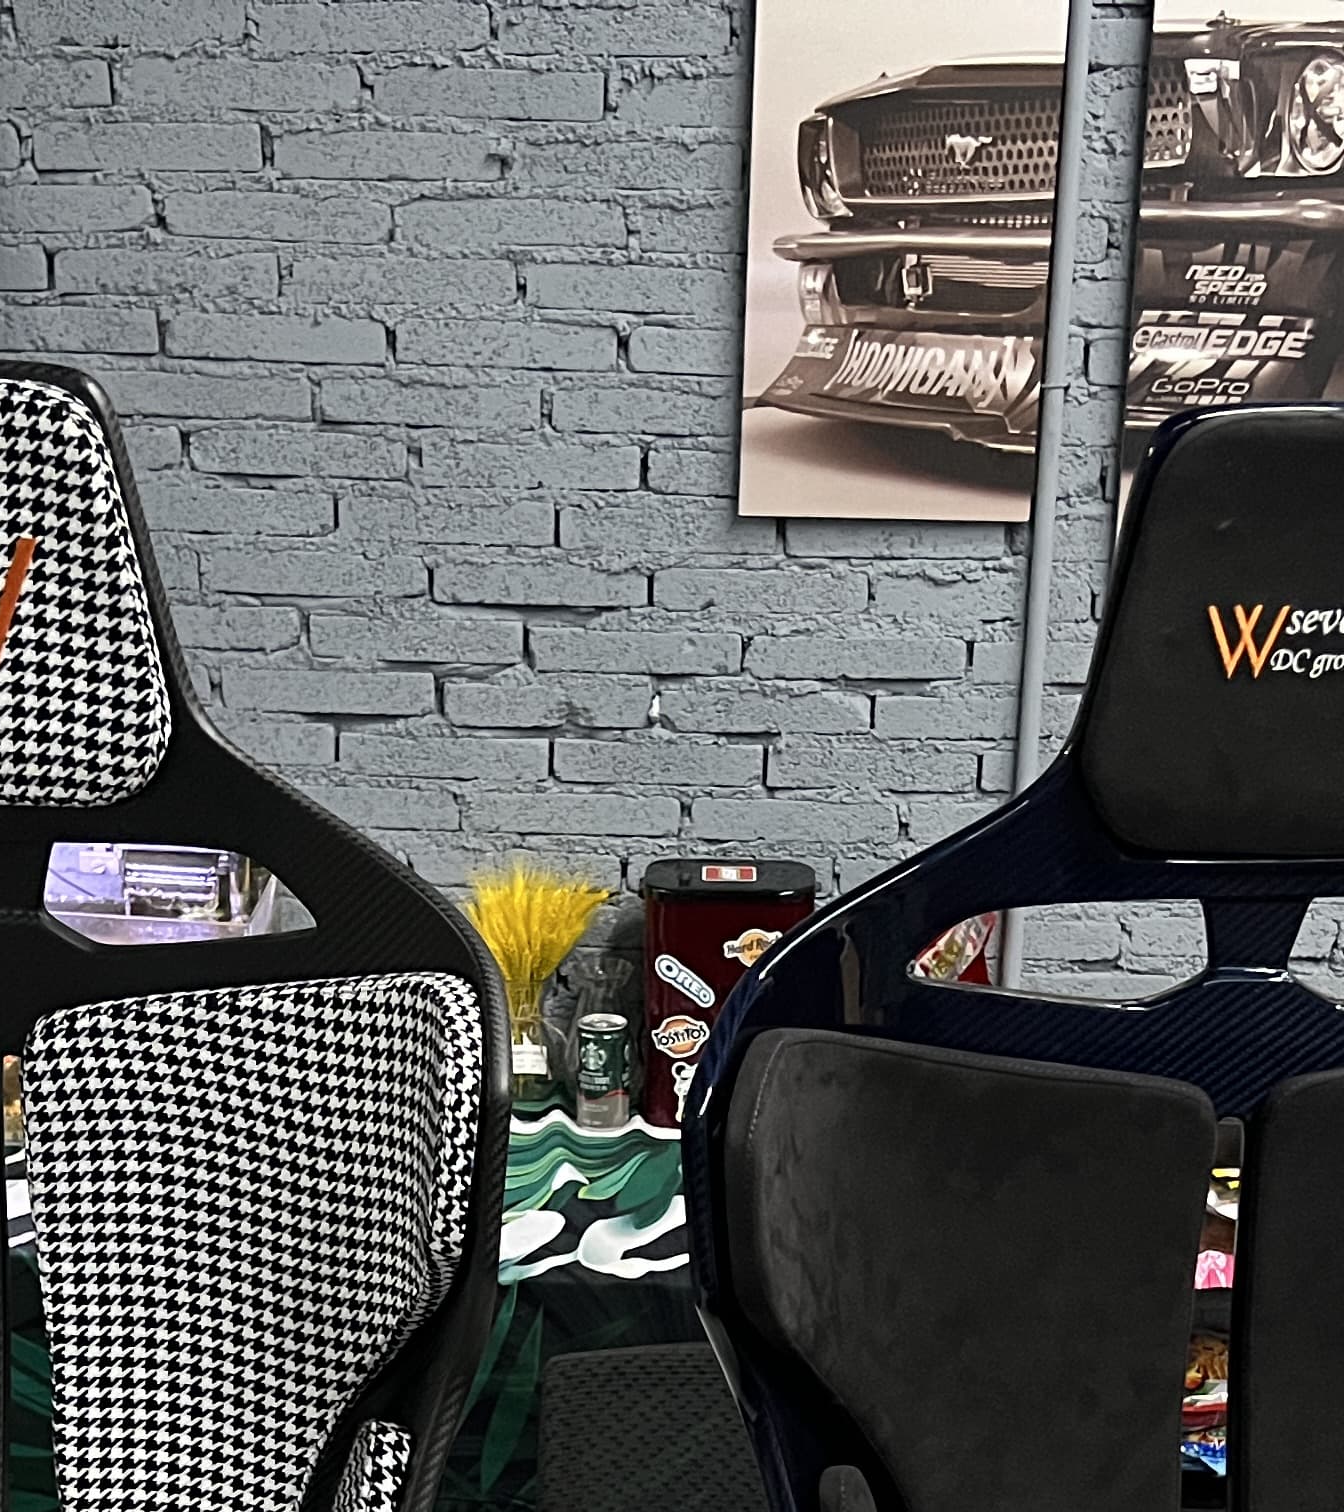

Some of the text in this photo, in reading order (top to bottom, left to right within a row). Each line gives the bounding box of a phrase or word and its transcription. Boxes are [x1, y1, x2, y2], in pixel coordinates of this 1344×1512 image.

[1184, 264, 1246, 280] NEED
[1193, 280, 1268, 297] SPEED
[1149, 328, 1314, 359] Castrol EDGE
[1151, 378, 1251, 395] GoPro
[1270, 649, 1311, 673] DC
[657, 957, 712, 1004] OREO
